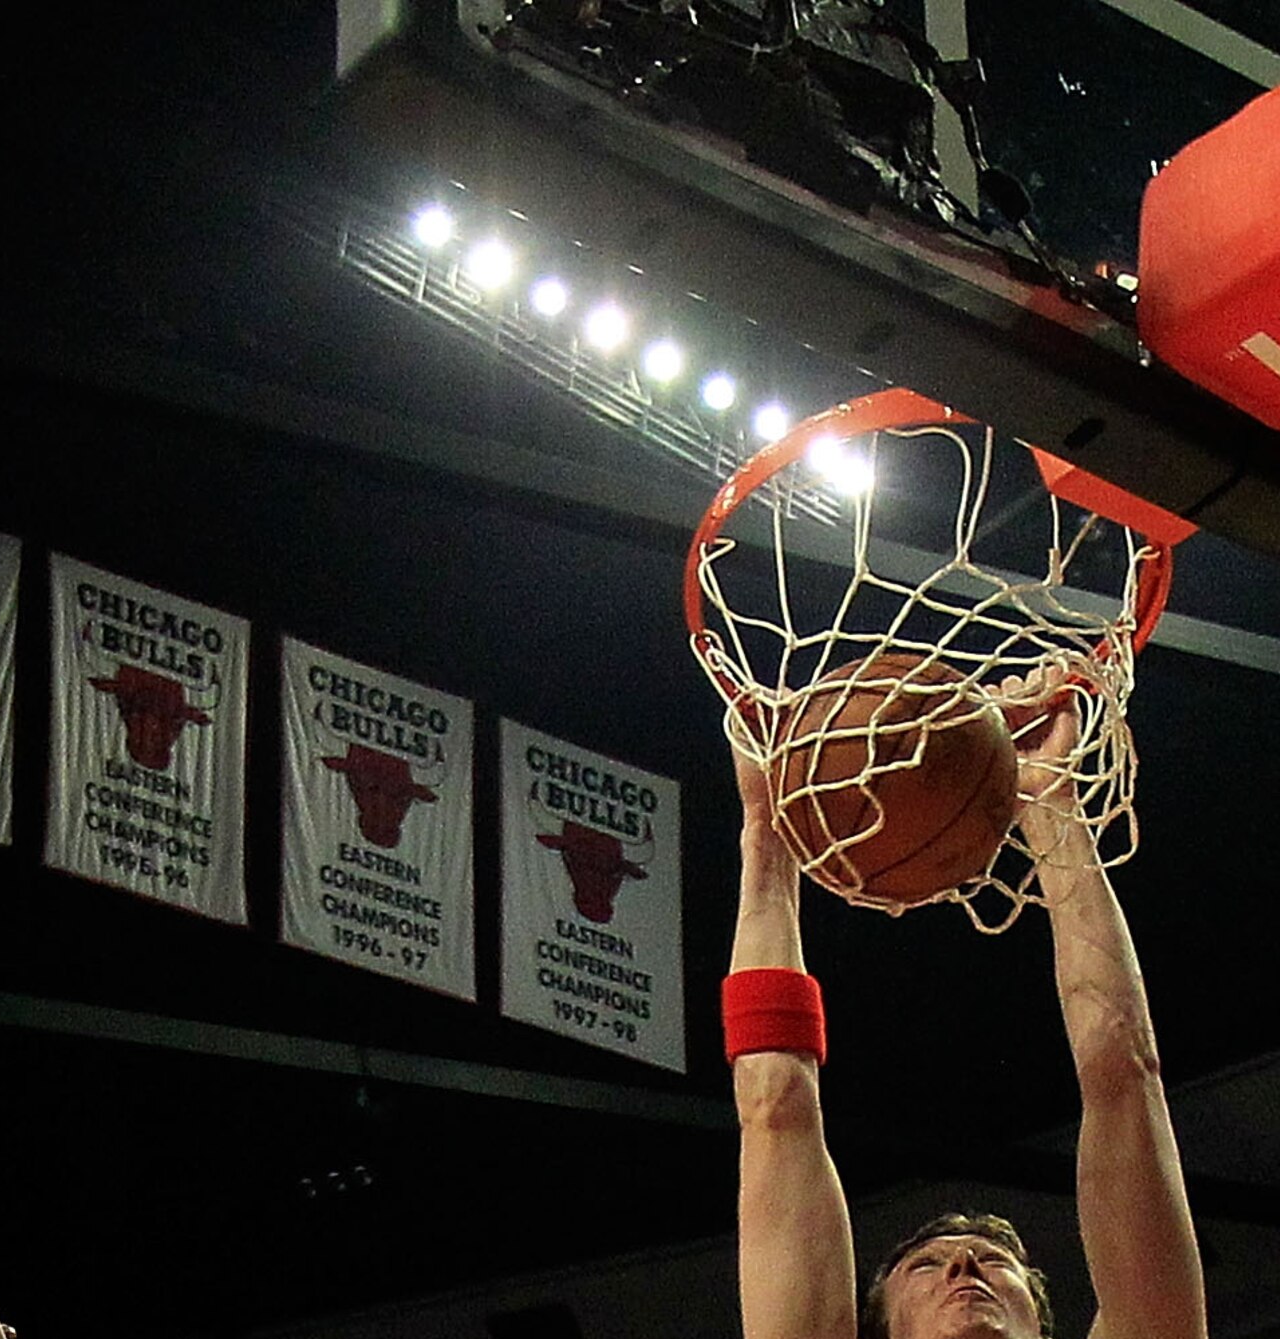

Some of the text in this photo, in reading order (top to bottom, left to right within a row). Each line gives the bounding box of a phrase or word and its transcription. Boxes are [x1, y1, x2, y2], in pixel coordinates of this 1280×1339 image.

[77, 583, 222, 654] CHICAGO
[102, 623, 203, 679] BULLS
[310, 665, 448, 733] CHICAGO
[332, 703, 427, 758] BULLS
[106, 760, 190, 800] EASTERN
[527, 747, 658, 813] CHICAGO
[86, 782, 212, 839] CONFERENCE
[547, 783, 640, 837] BULLS
[340, 843, 421, 886] EASTERN
[320, 865, 442, 920] CONFERENCE
[323, 893, 440, 947] CHAMPIONS
[557, 919, 634, 959] EASTERN
[537, 940, 653, 993] CONFERENCE
[538, 968, 651, 1019] CHAMPIONS
